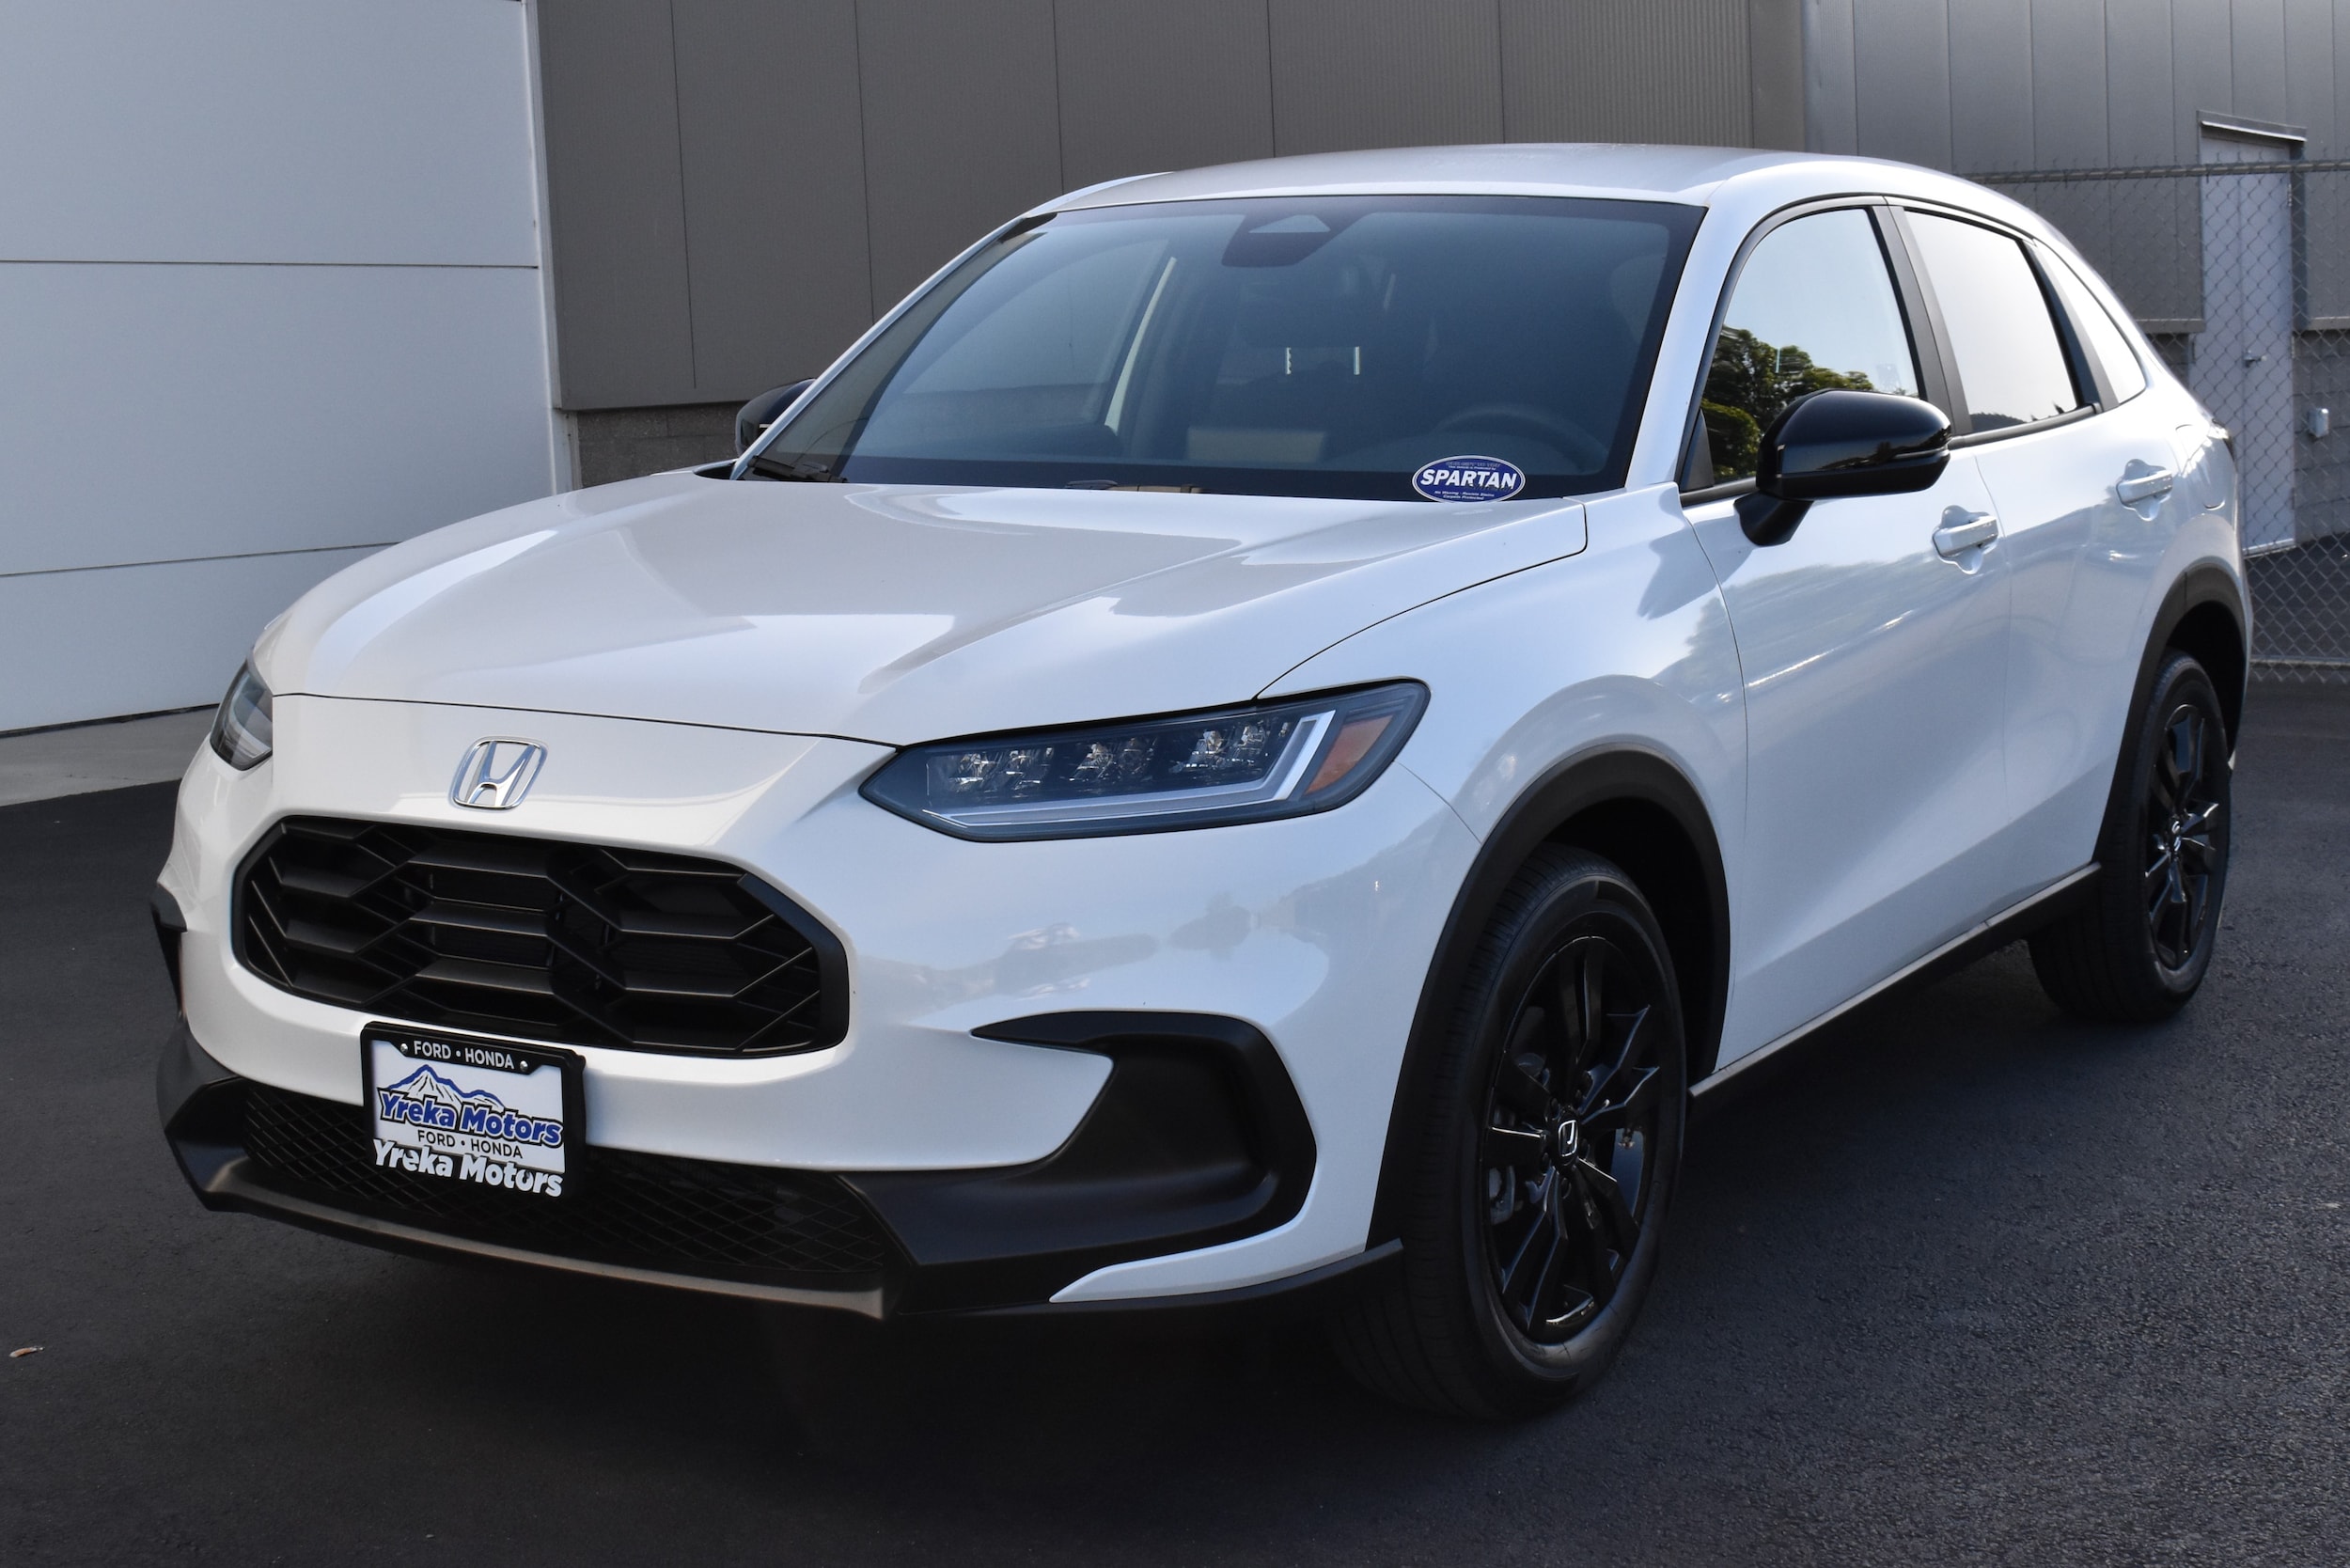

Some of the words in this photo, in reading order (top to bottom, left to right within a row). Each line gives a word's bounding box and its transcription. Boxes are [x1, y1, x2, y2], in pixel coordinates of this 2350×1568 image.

[1420, 469, 1517, 489] SPARTAN
[413, 1040, 451, 1059] FORD
[465, 1048, 514, 1070] HONDA
[380, 1090, 456, 1129] Yreka
[461, 1103, 564, 1146] Motors
[417, 1130, 456, 1147] FORD
[471, 1139, 524, 1159] HONDA
[373, 1138, 453, 1177] Yreka
[459, 1153, 563, 1198] Motors
